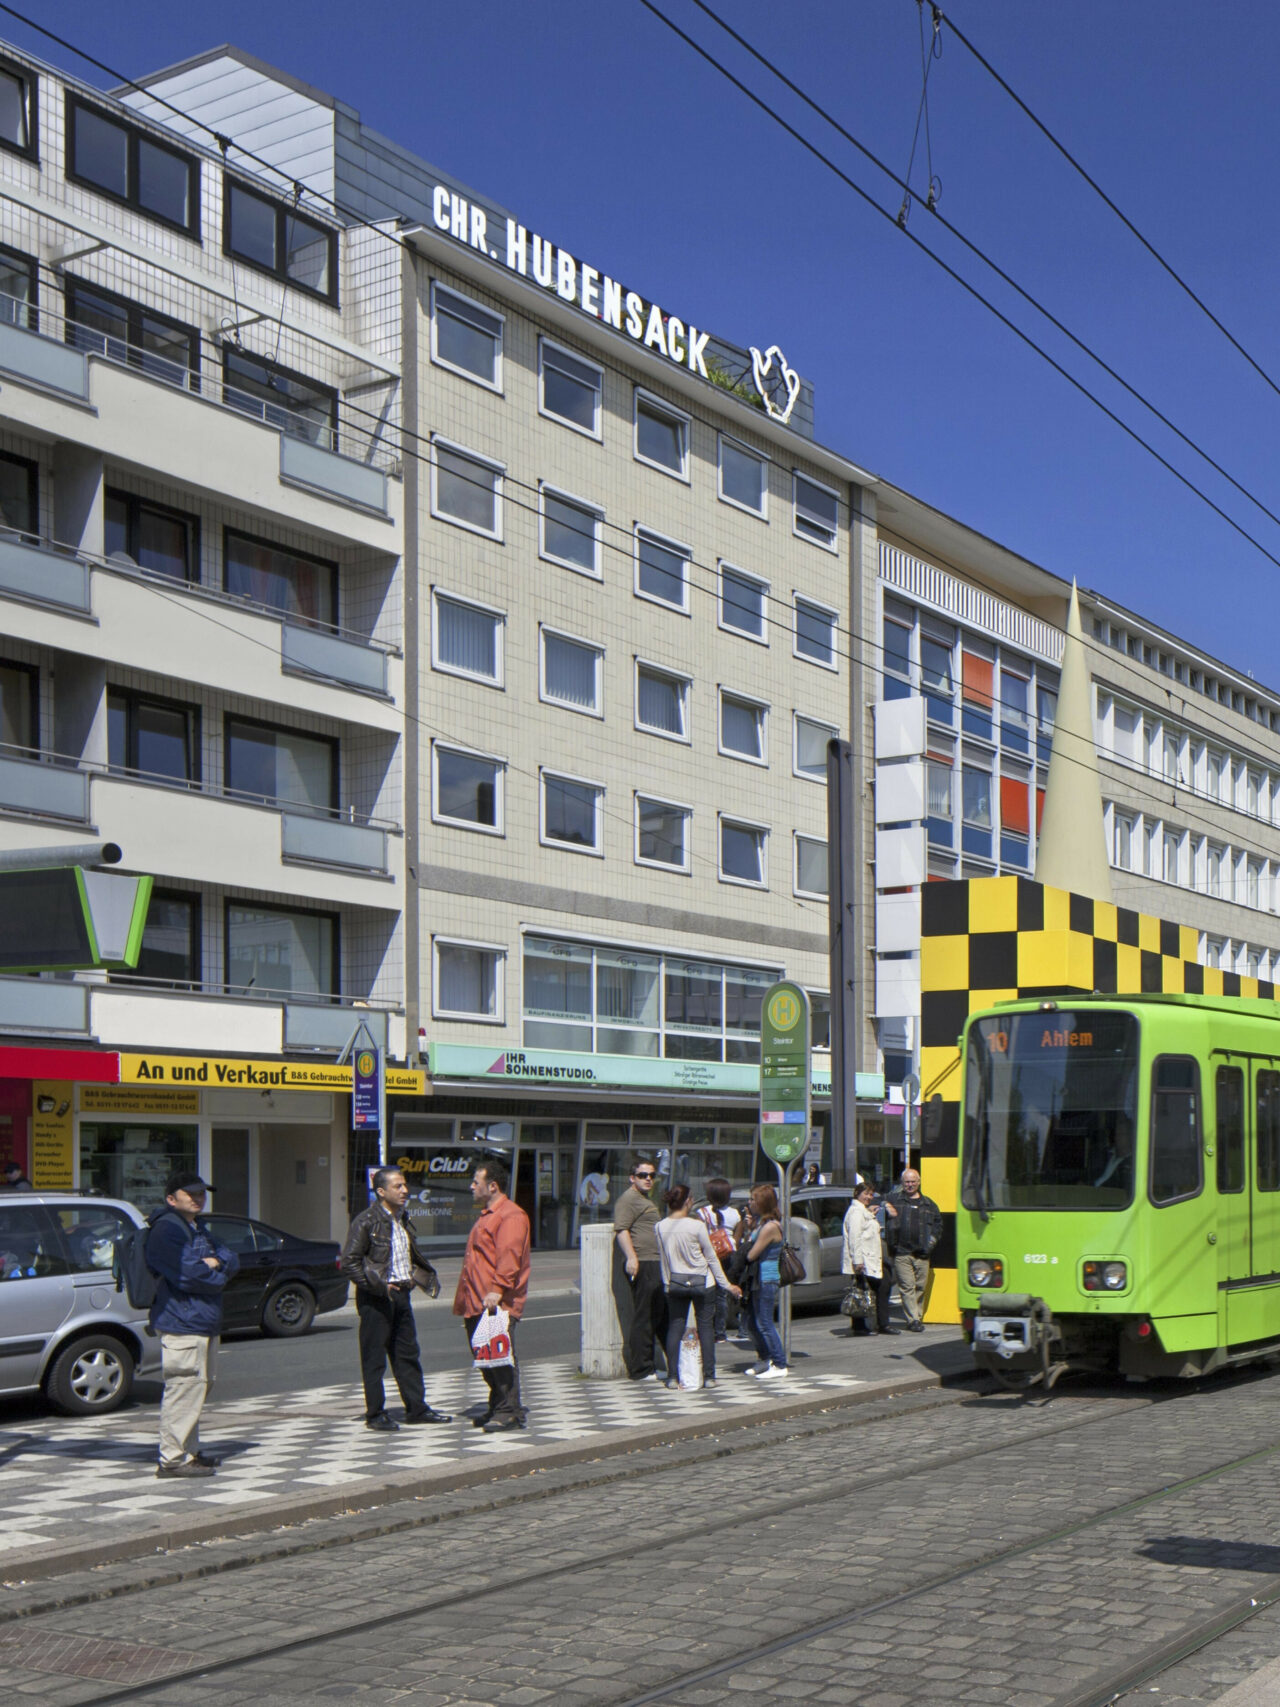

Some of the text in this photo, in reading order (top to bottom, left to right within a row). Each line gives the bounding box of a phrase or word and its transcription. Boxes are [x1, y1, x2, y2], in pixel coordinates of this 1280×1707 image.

[433, 185, 711, 379] CHR. HUBENSACK
[986, 1029, 1093, 1053] 10 Ahlem
[506, 1052, 526, 1064] IHR
[136, 1059, 164, 1080] An
[171, 1062, 208, 1082] und
[214, 1064, 288, 1085] Verkauf
[396, 1076, 418, 1085] GmbH
[505, 1064, 597, 1080] SONNENSTUDIO.
[764, 1067, 772, 1076] 17
[1023, 1253, 1048, 1264] 6123
